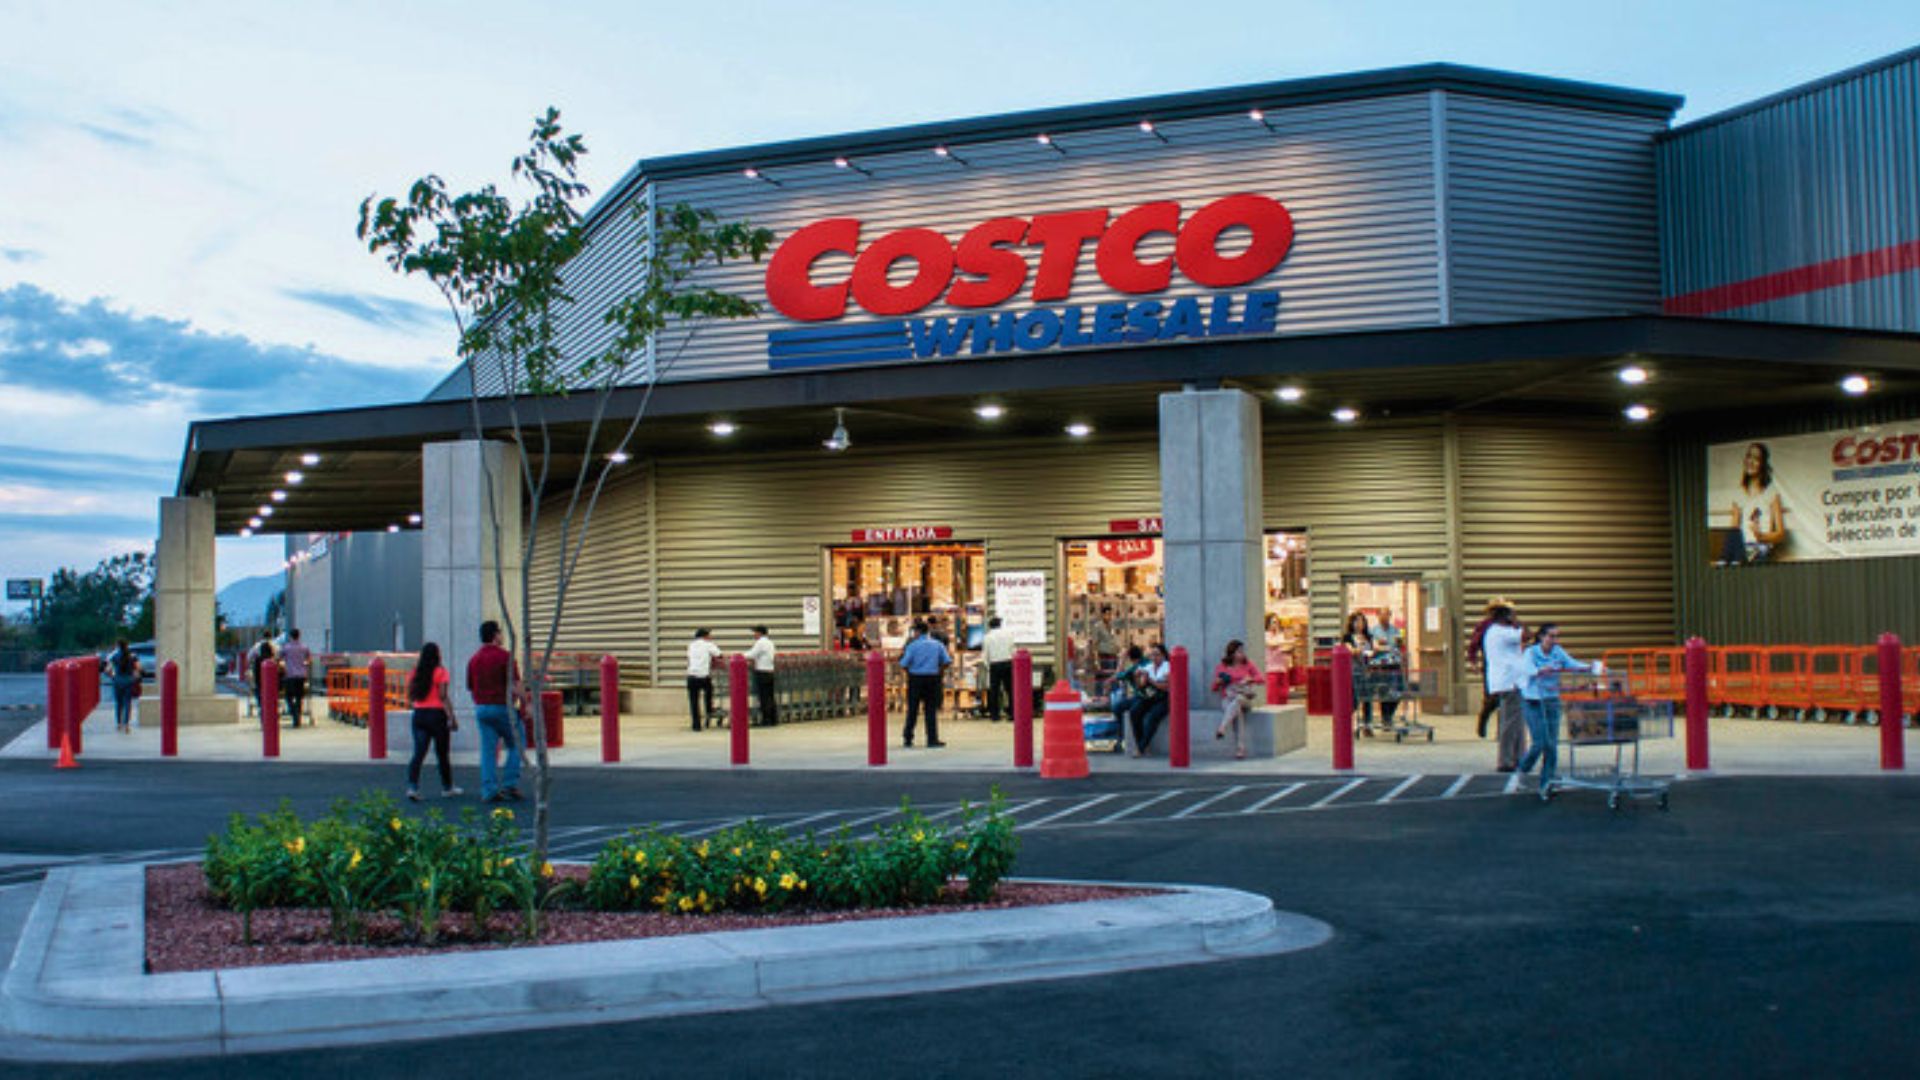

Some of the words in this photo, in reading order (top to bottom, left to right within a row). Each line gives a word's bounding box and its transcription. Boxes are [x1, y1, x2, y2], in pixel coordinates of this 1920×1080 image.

[765, 193, 1294, 321] COSTCO
[908, 291, 1281, 359] WHOLESALE
[1832, 434, 1920, 467] COST
[1822, 488, 1881, 506] Compre
[1886, 485, 1912, 504] por
[1138, 518, 1161, 532] SA
[1825, 512, 1834, 527] y
[1837, 505, 1902, 524] descubra
[865, 527, 936, 541] ENTRADA
[1898, 521, 1916, 537] de
[996, 576, 1042, 588] Horario
